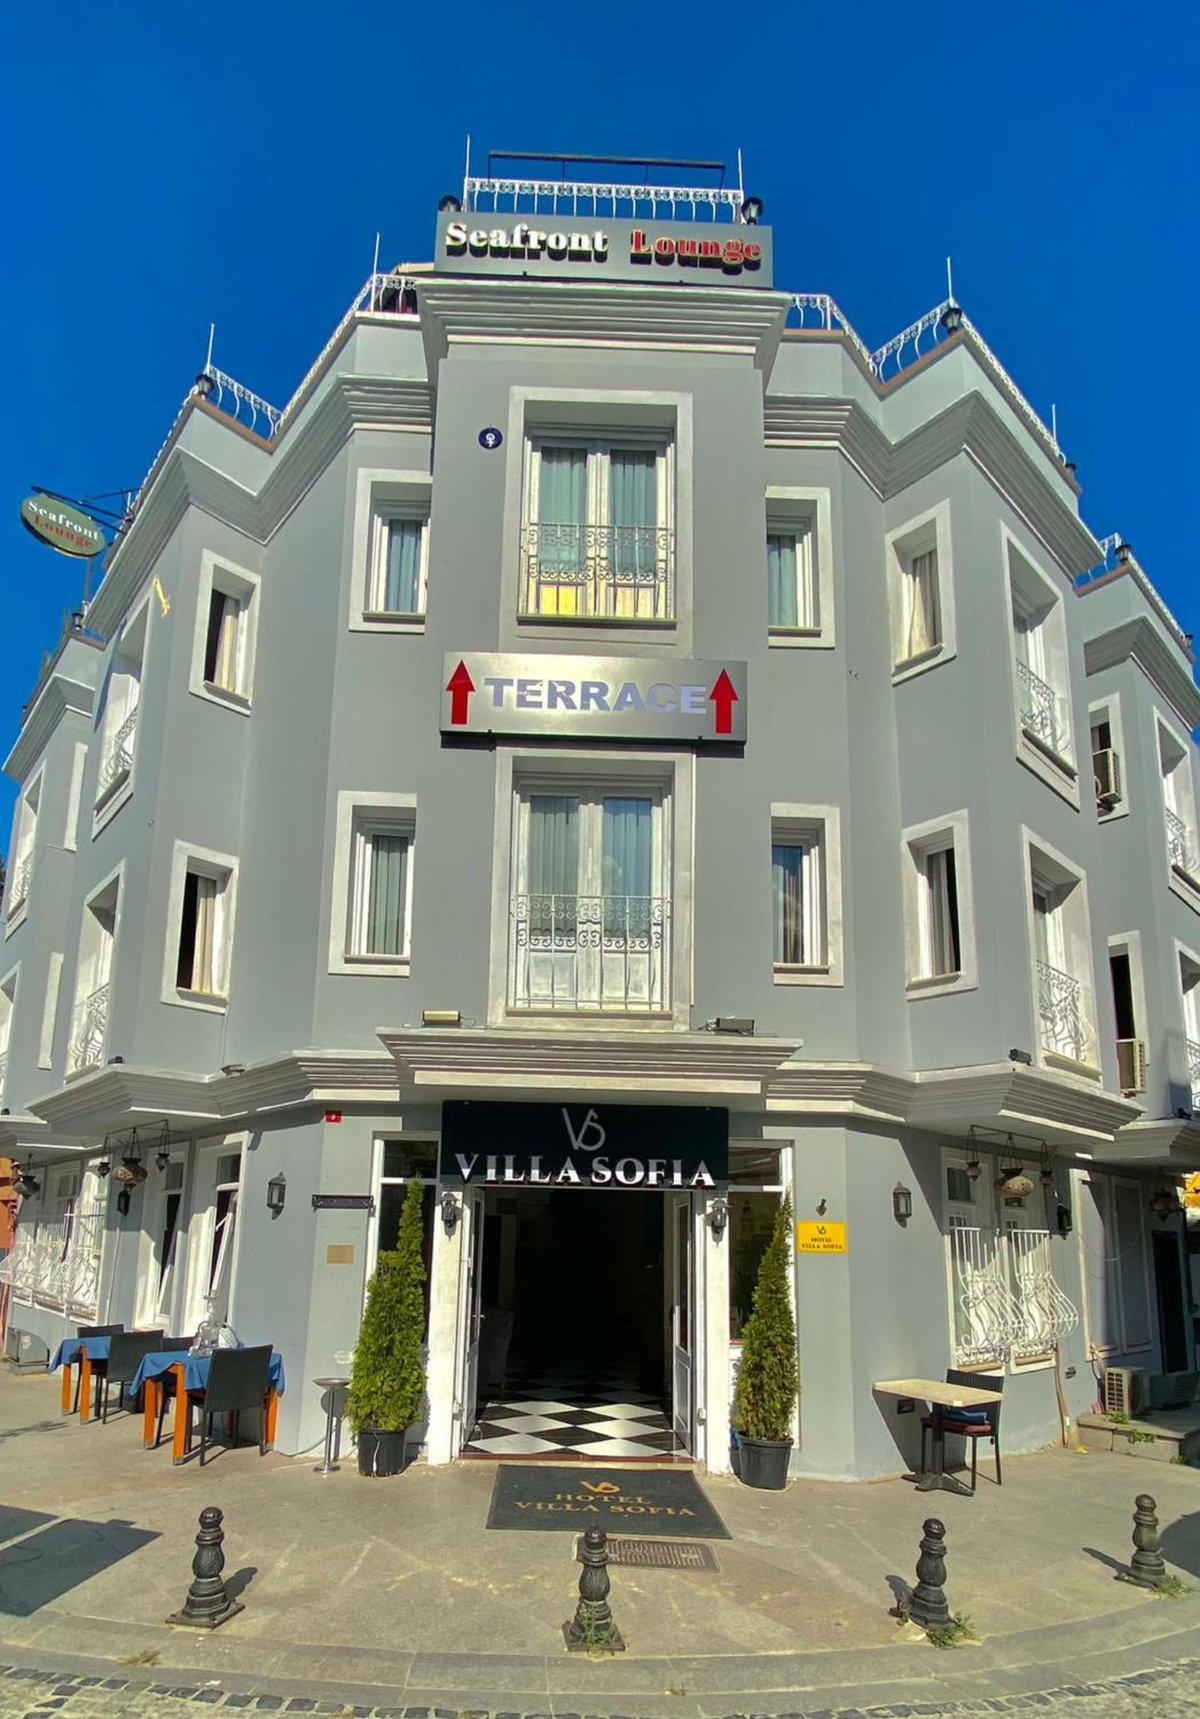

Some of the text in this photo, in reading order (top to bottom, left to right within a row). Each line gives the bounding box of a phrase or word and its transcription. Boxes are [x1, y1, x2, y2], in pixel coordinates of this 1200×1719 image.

[445, 222, 763, 267] Seafront Lounge
[28, 501, 98, 541] Seafront
[484, 677, 707, 714] TERRACE
[454, 1153, 717, 1187] VILLA SOFIA
[514, 1501, 697, 1517] VILLA SOFIA
[554, 1493, 652, 1504] HOTEL
